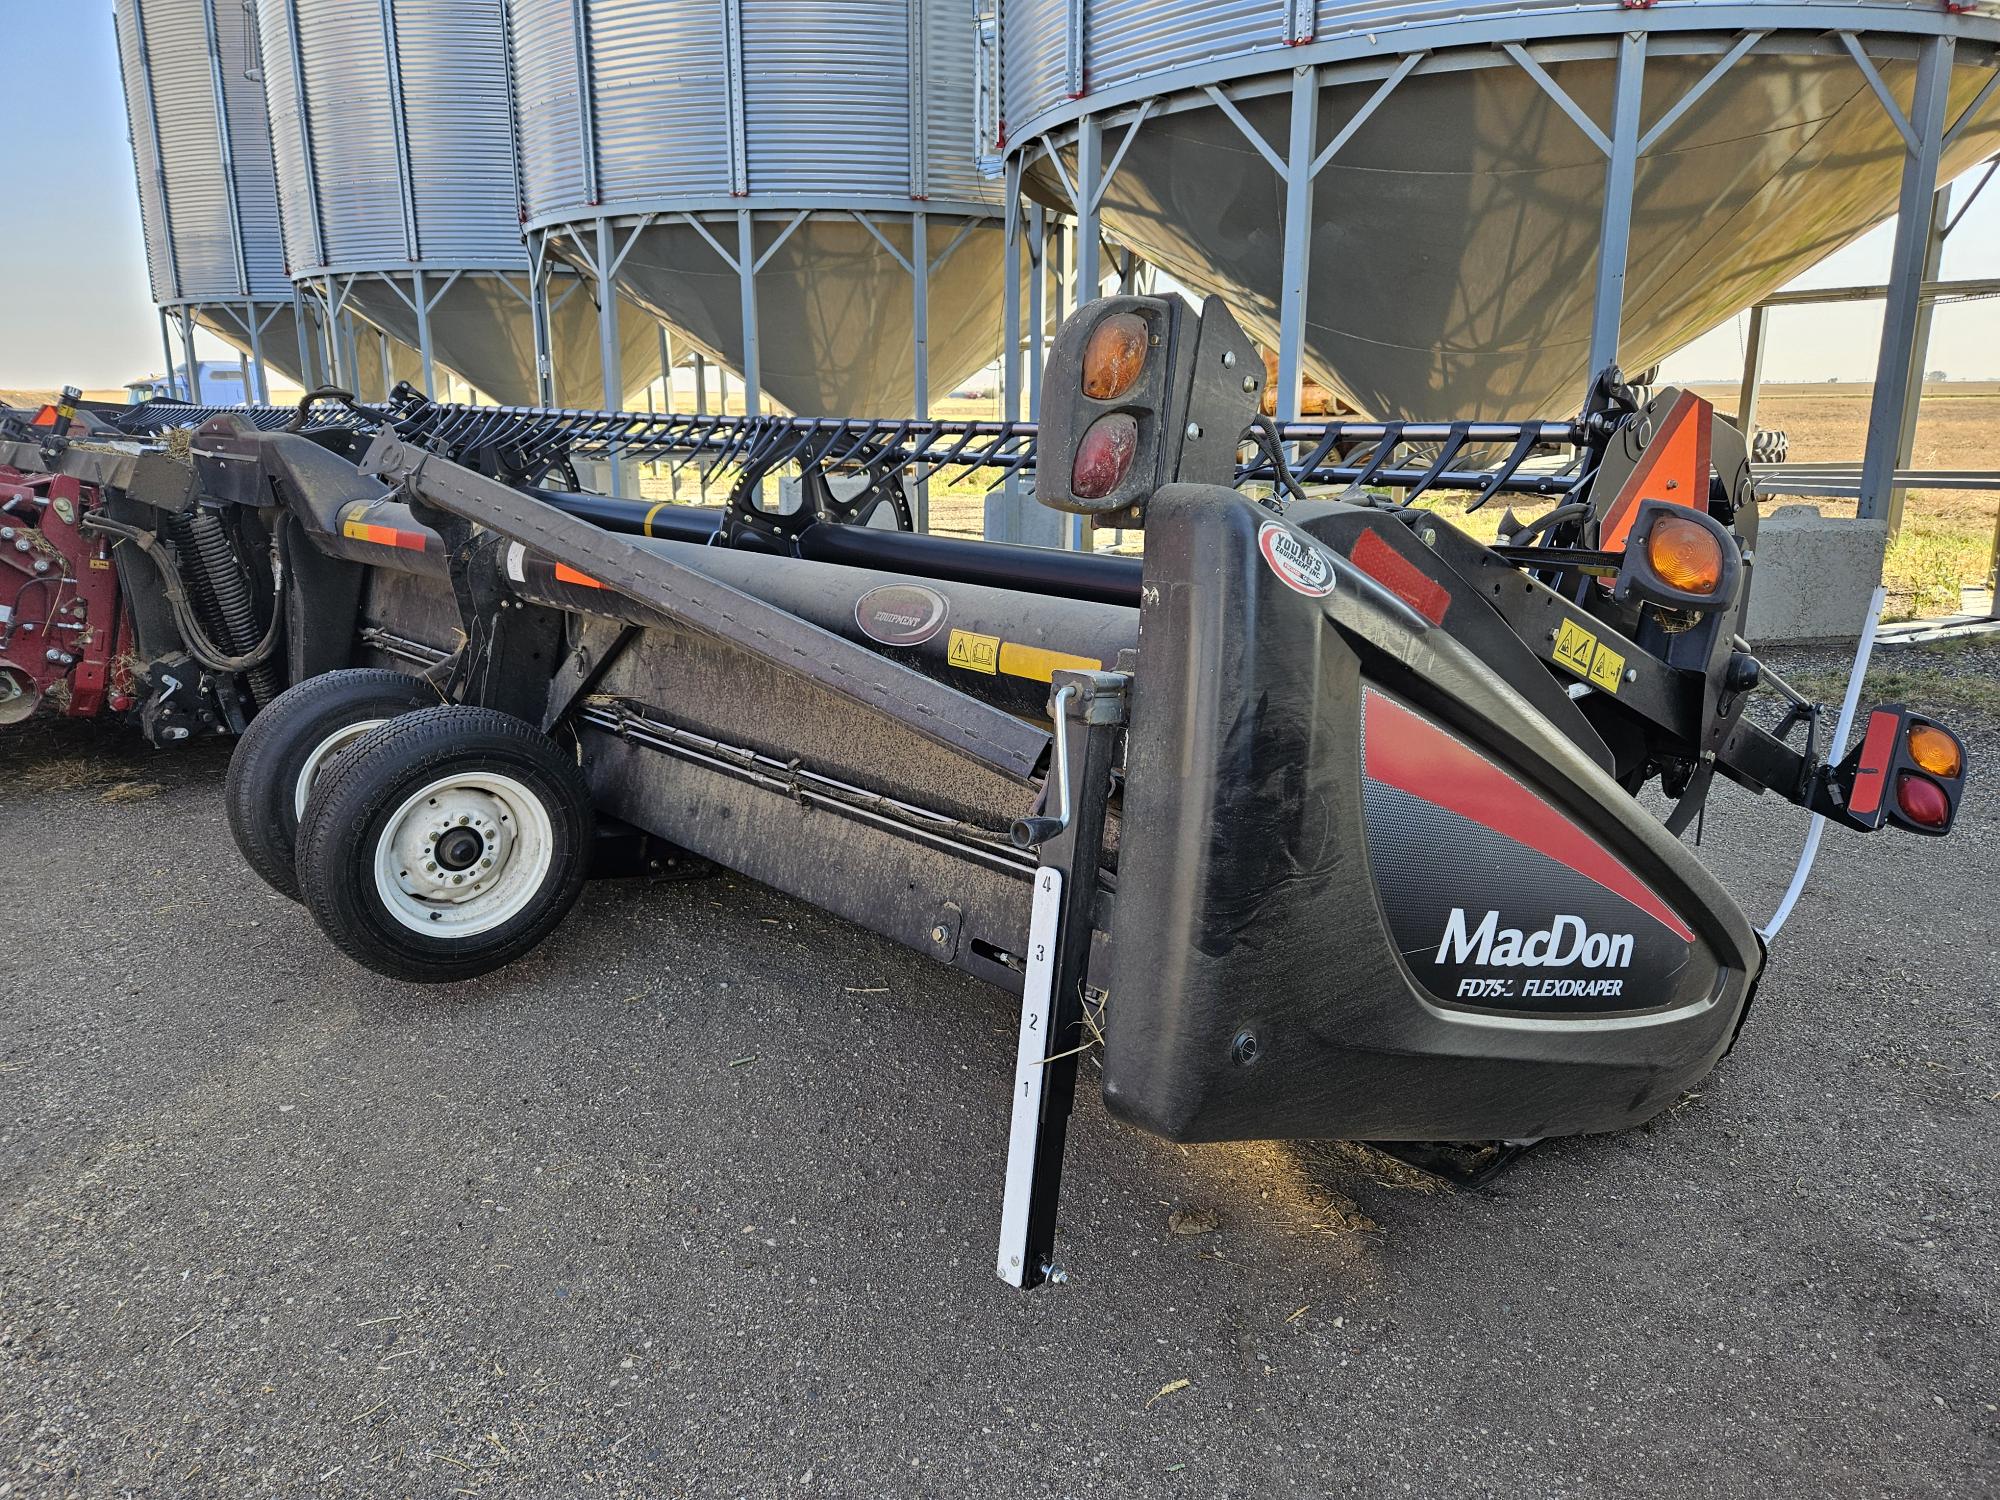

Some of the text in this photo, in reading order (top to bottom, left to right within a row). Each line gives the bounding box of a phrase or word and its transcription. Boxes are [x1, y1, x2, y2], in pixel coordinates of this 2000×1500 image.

[1275, 545, 1310, 571] EQUIPMENT
[1309, 569, 1321, 580] INC.
[875, 611, 921, 627] EQUIPMENT
[1042, 875, 1051, 892] 4
[1434, 907, 1634, 968] MacDon
[1036, 944, 1045, 962] 3
[1521, 979, 1624, 997] FLEXDRAPER
[1028, 1013, 1038, 1031] 2
[1023, 1081, 1029, 1098] 1
